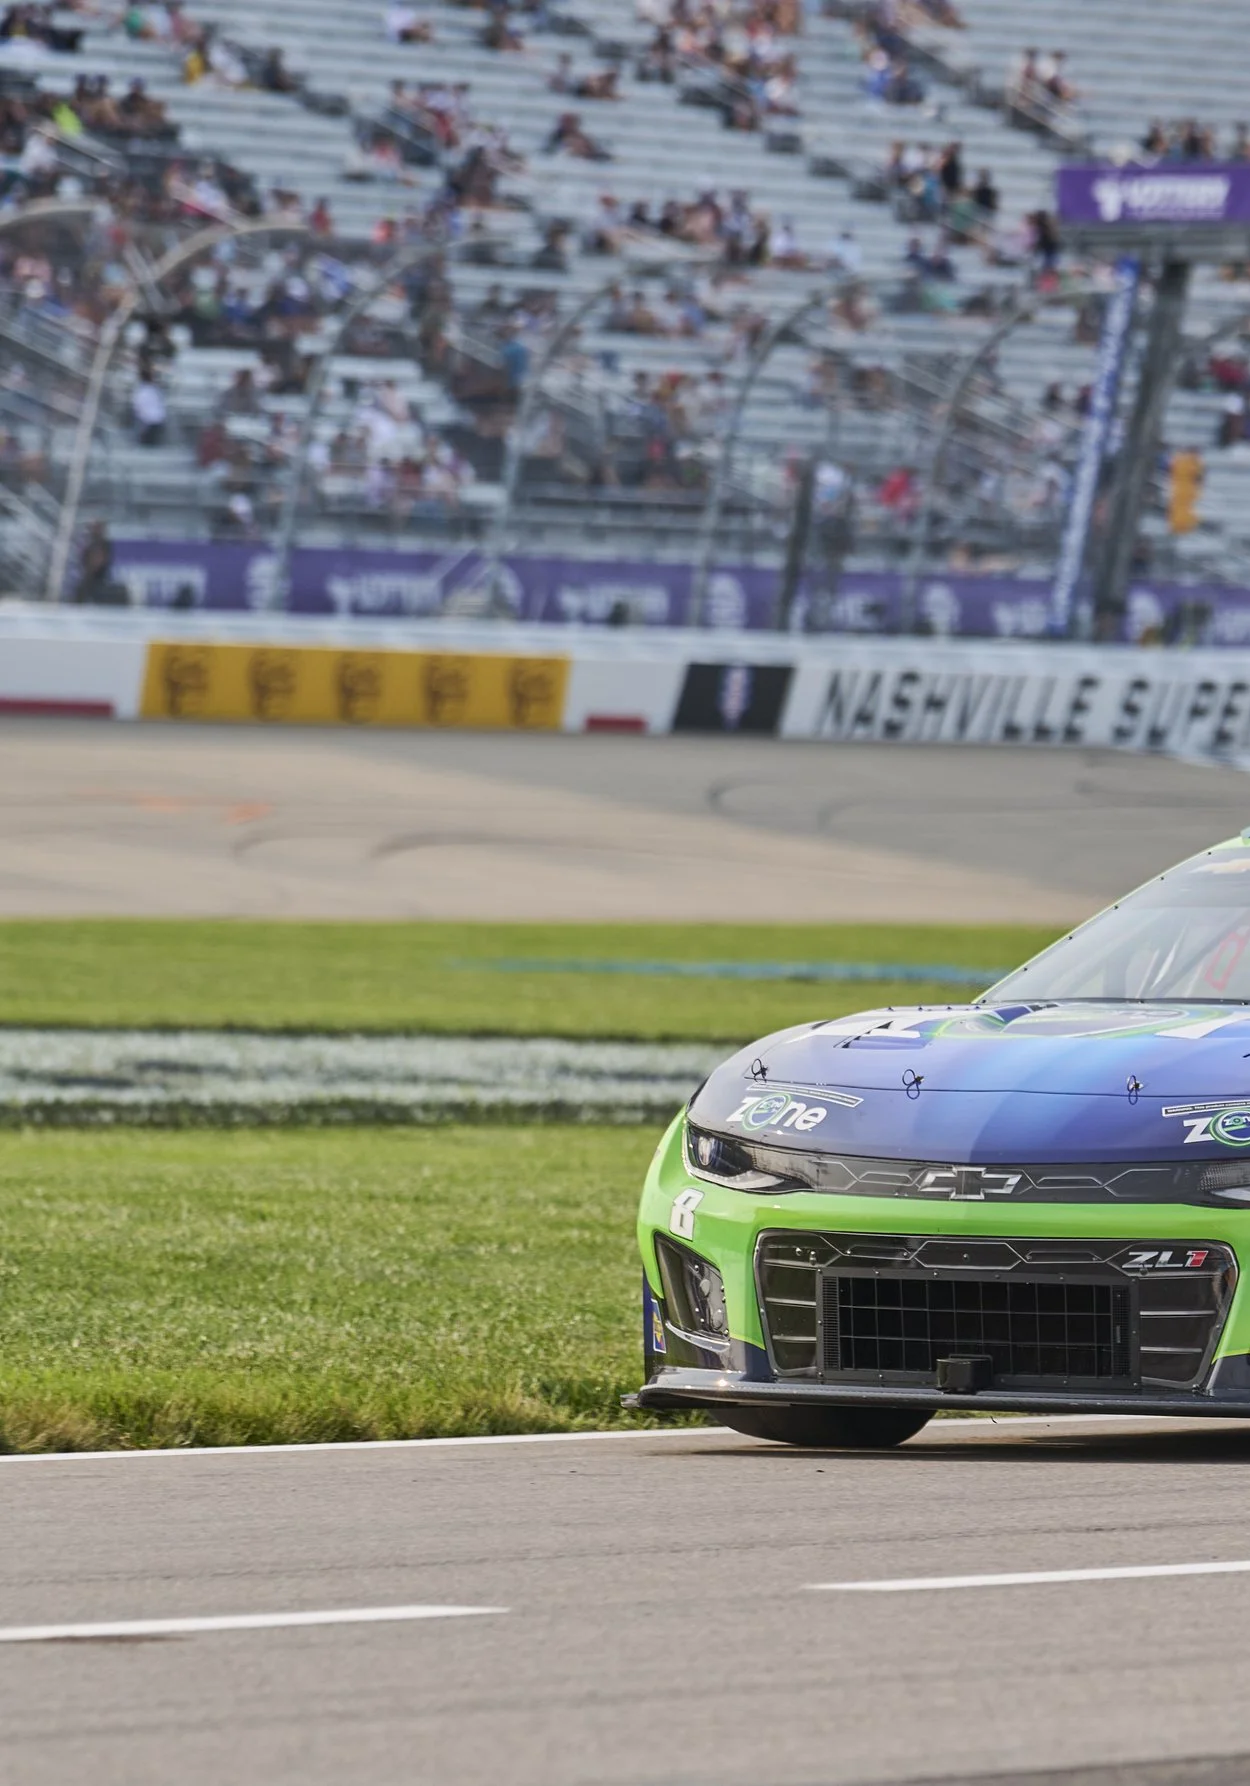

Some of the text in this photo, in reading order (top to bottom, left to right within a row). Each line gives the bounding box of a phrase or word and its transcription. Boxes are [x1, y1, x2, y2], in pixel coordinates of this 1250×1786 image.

[815, 669, 1098, 742] NASHVILLE
[726, 1093, 827, 1131] zone
[669, 1187, 705, 1242] 8
[1122, 1249, 1209, 1269] ZL1
